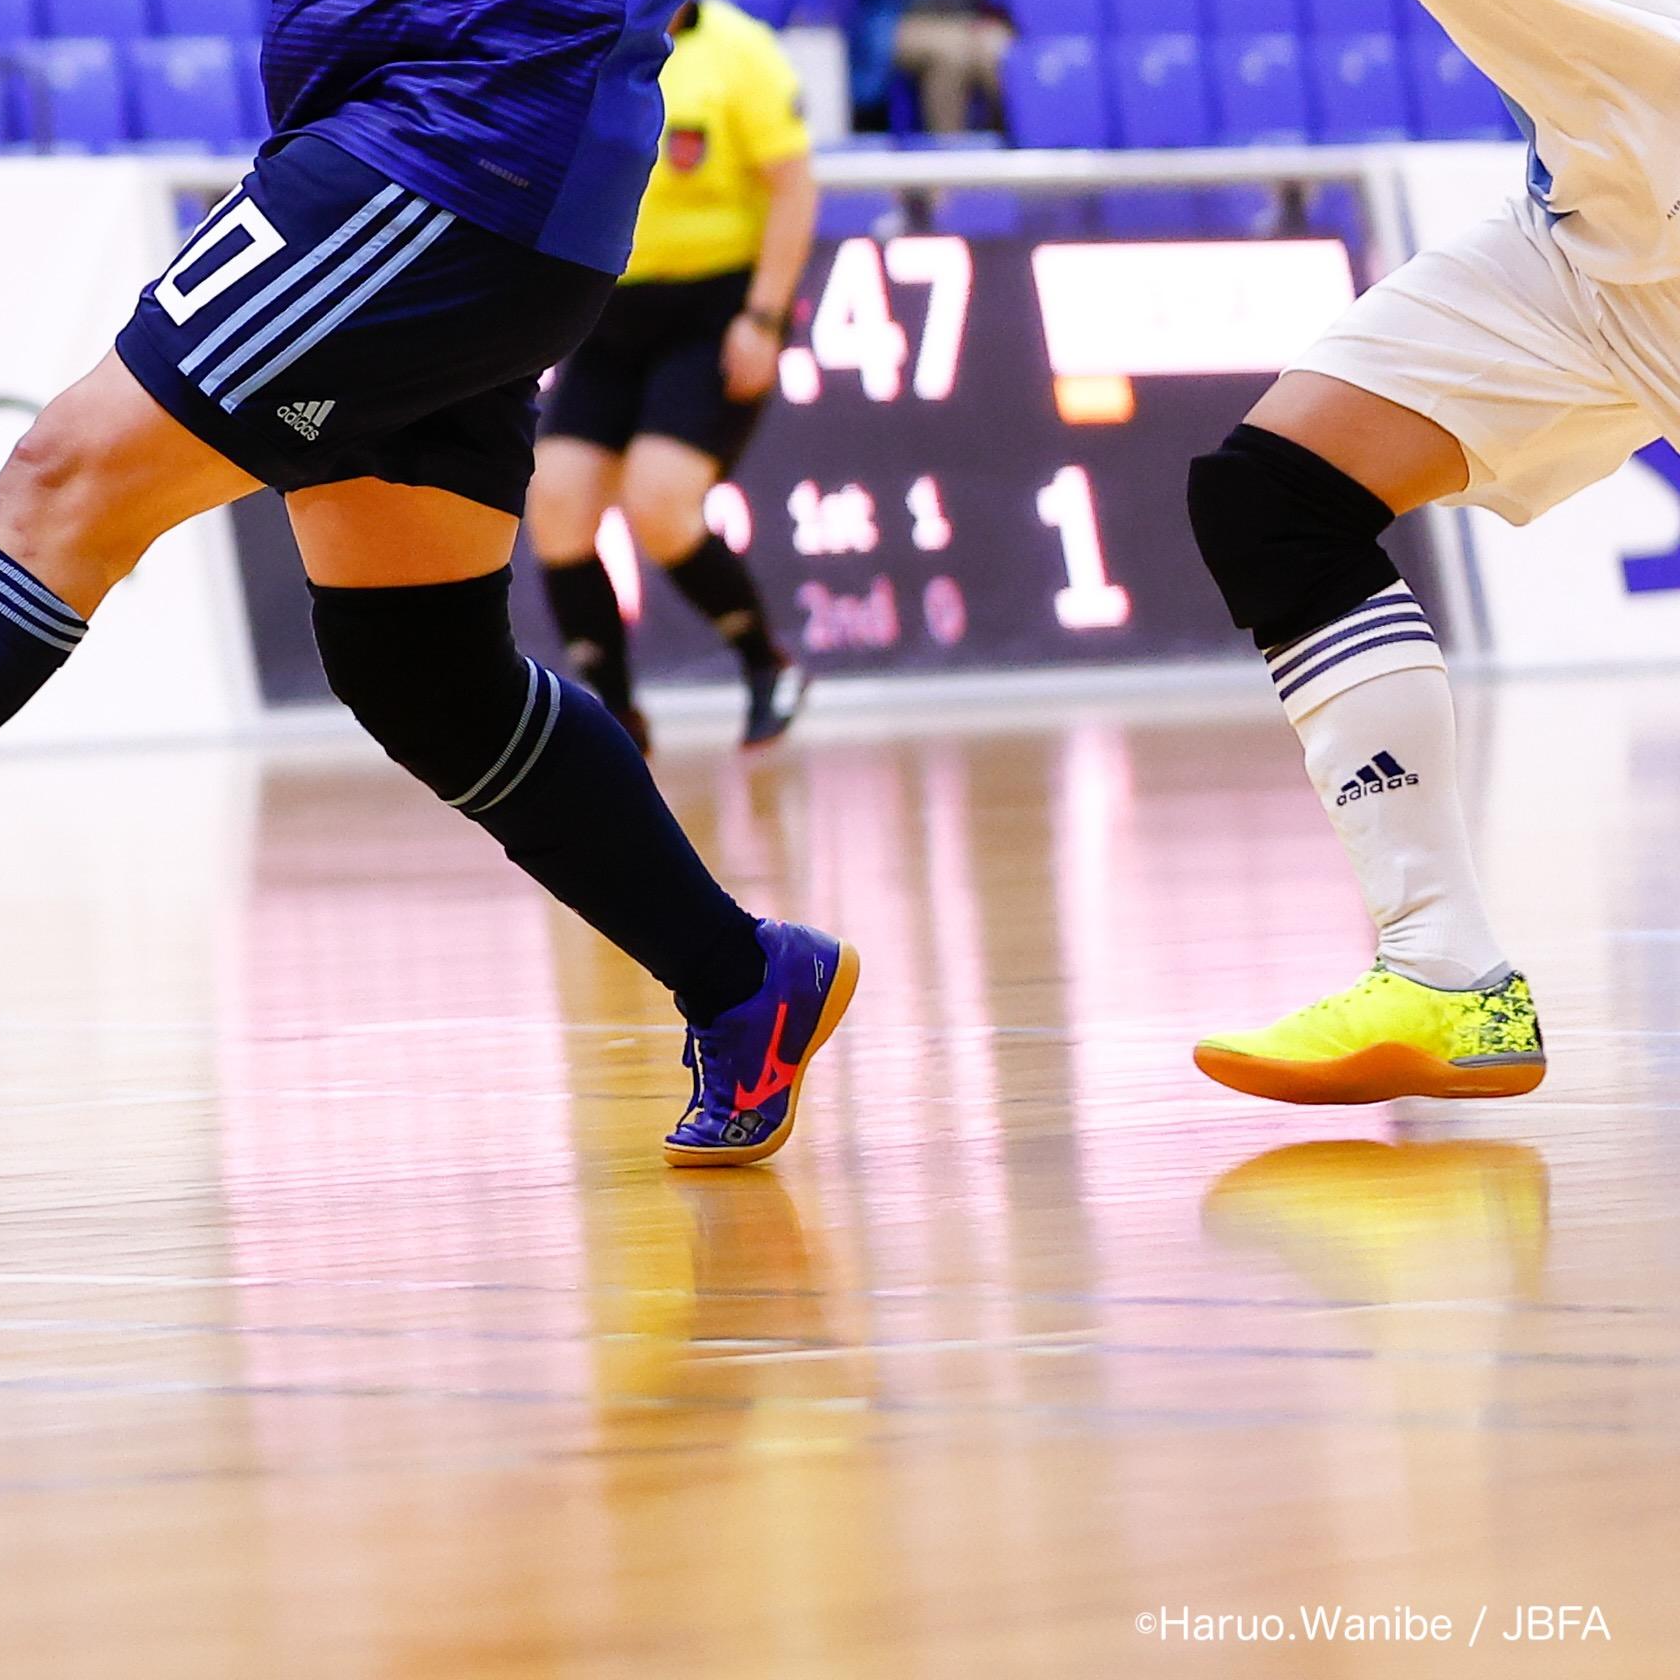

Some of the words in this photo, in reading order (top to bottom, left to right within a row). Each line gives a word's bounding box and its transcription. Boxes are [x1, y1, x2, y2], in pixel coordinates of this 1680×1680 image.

[277, 405, 320, 441] adidas
[1036, 463, 1133, 630] 1
[1336, 773, 1419, 806] adidas
